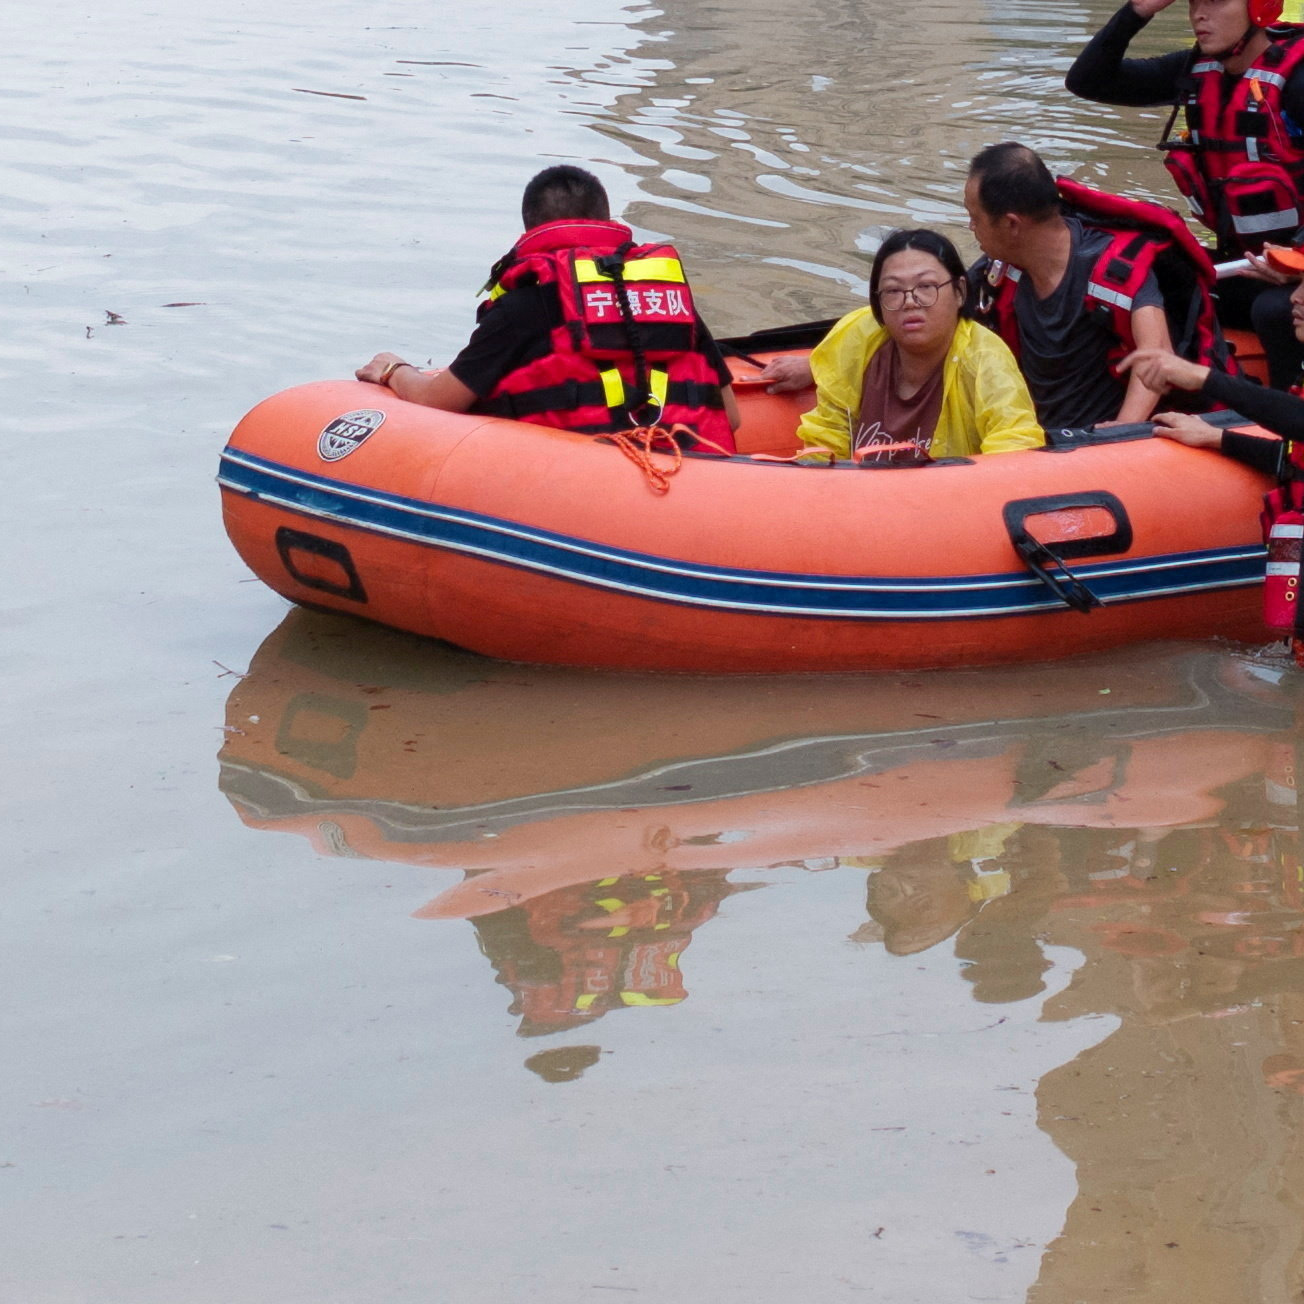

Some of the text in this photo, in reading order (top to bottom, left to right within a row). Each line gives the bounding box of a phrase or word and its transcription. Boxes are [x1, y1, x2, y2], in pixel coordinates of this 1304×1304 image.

[586, 288, 690, 317] 宁德支队
[330, 422, 369, 439] HSP
